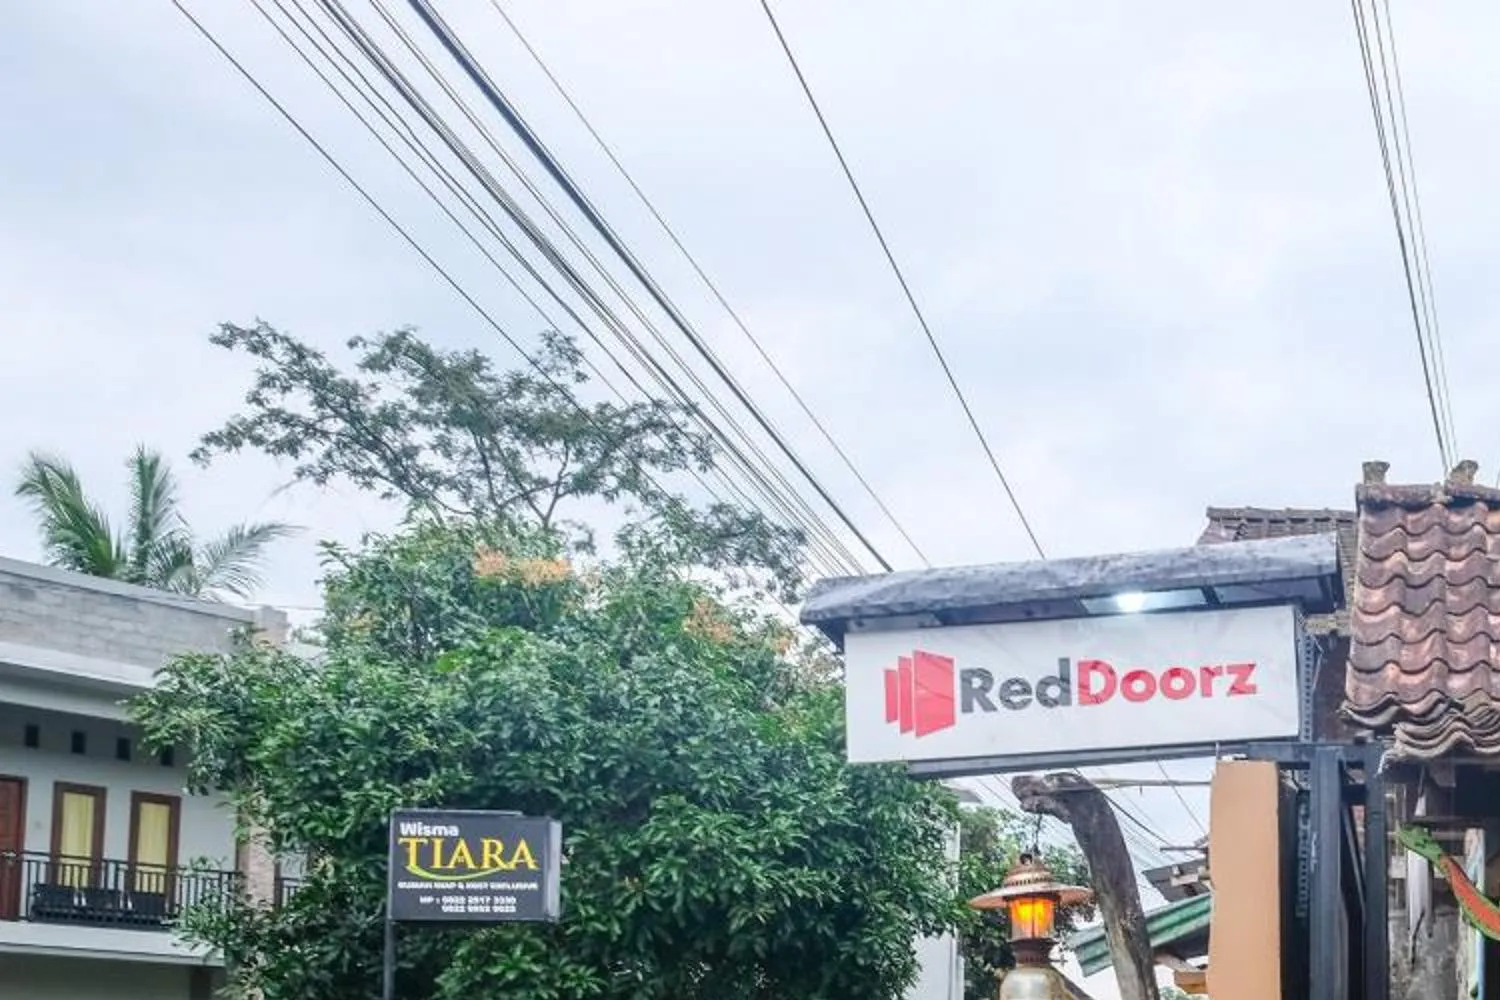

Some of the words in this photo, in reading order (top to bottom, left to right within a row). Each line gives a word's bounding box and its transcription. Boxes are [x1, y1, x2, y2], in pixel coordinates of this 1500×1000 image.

[959, 657, 1257, 713] RedDoorz
[399, 822, 459, 837] Wisma
[397, 837, 540, 871] TIARA
